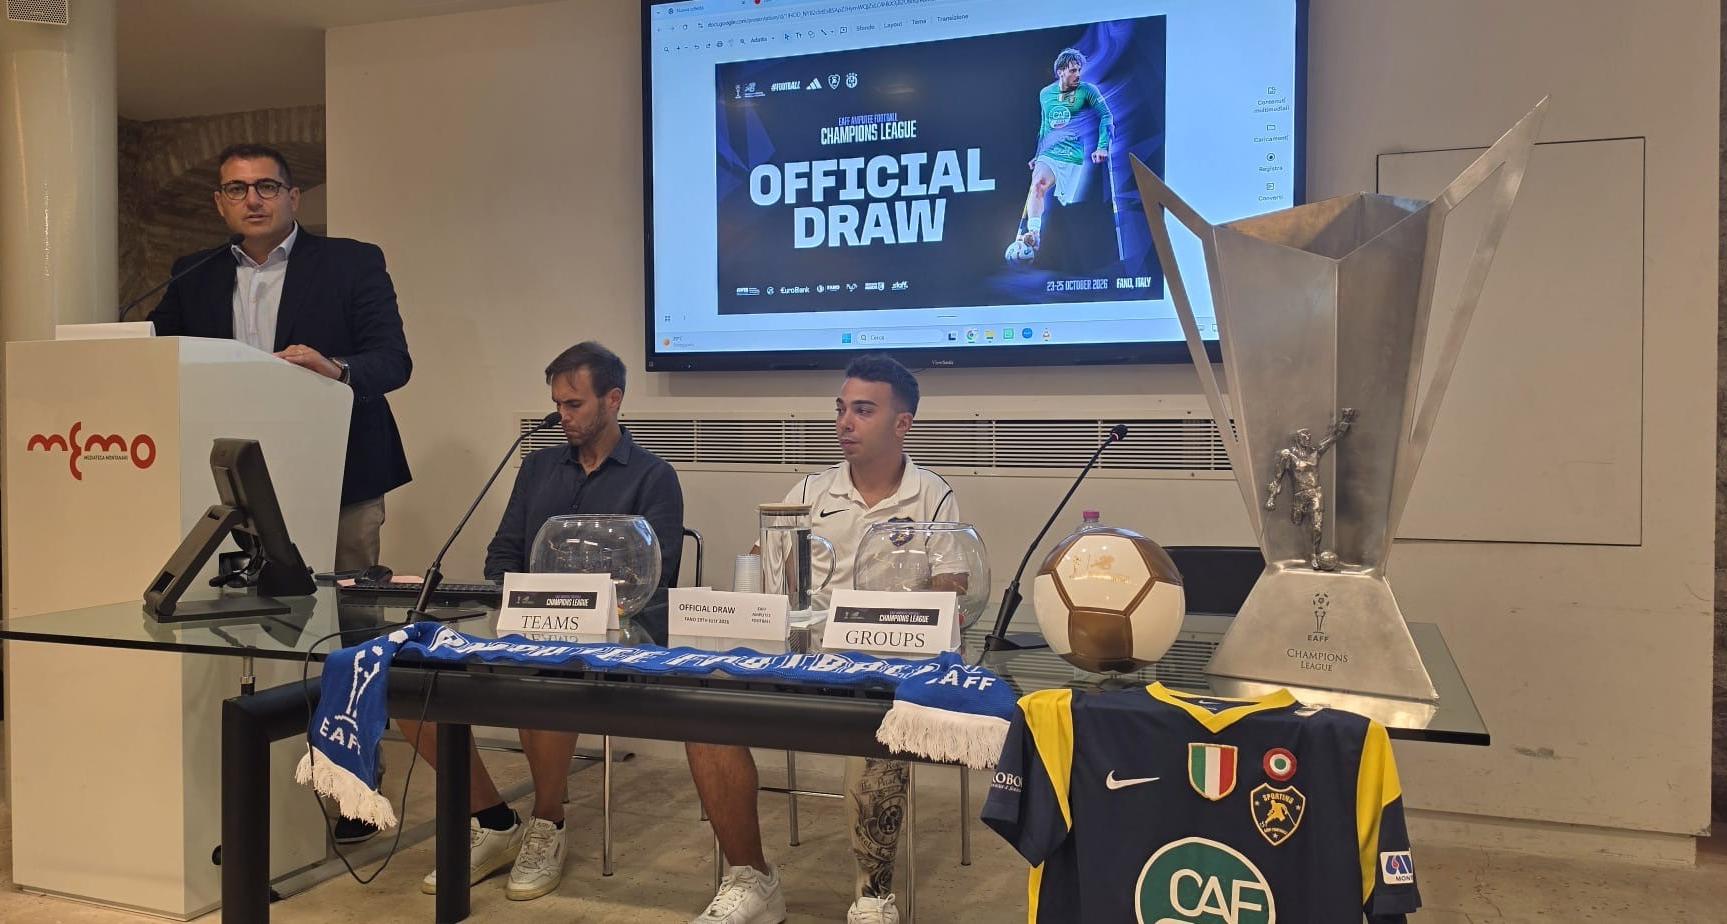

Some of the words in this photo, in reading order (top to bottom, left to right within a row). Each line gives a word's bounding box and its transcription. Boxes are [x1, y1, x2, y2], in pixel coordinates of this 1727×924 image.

[912, 18, 927, 26] Tema
[820, 125, 878, 145] CHAMPIONS
[880, 120, 917, 141] LEAGUE
[749, 148, 996, 206] OFFICIAL
[794, 198, 947, 249] DRAW
[1046, 280, 1064, 291] 23-25
[1065, 279, 1092, 291] OCTOBER
[1092, 278, 1109, 290] 2026
[1135, 276, 1152, 288] ITALY
[546, 598, 572, 606] CHAMPIONS
[679, 604, 711, 612] OFFICIAL
[712, 606, 736, 614] DRAW
[522, 616, 579, 630] TEAMS
[879, 614, 909, 622] CHAMPIONS
[909, 615, 929, 623] LEAGUE
[845, 630, 925, 648] GROUPS
[1307, 634, 1330, 642] EAFF
[925, 670, 997, 691] AFF
